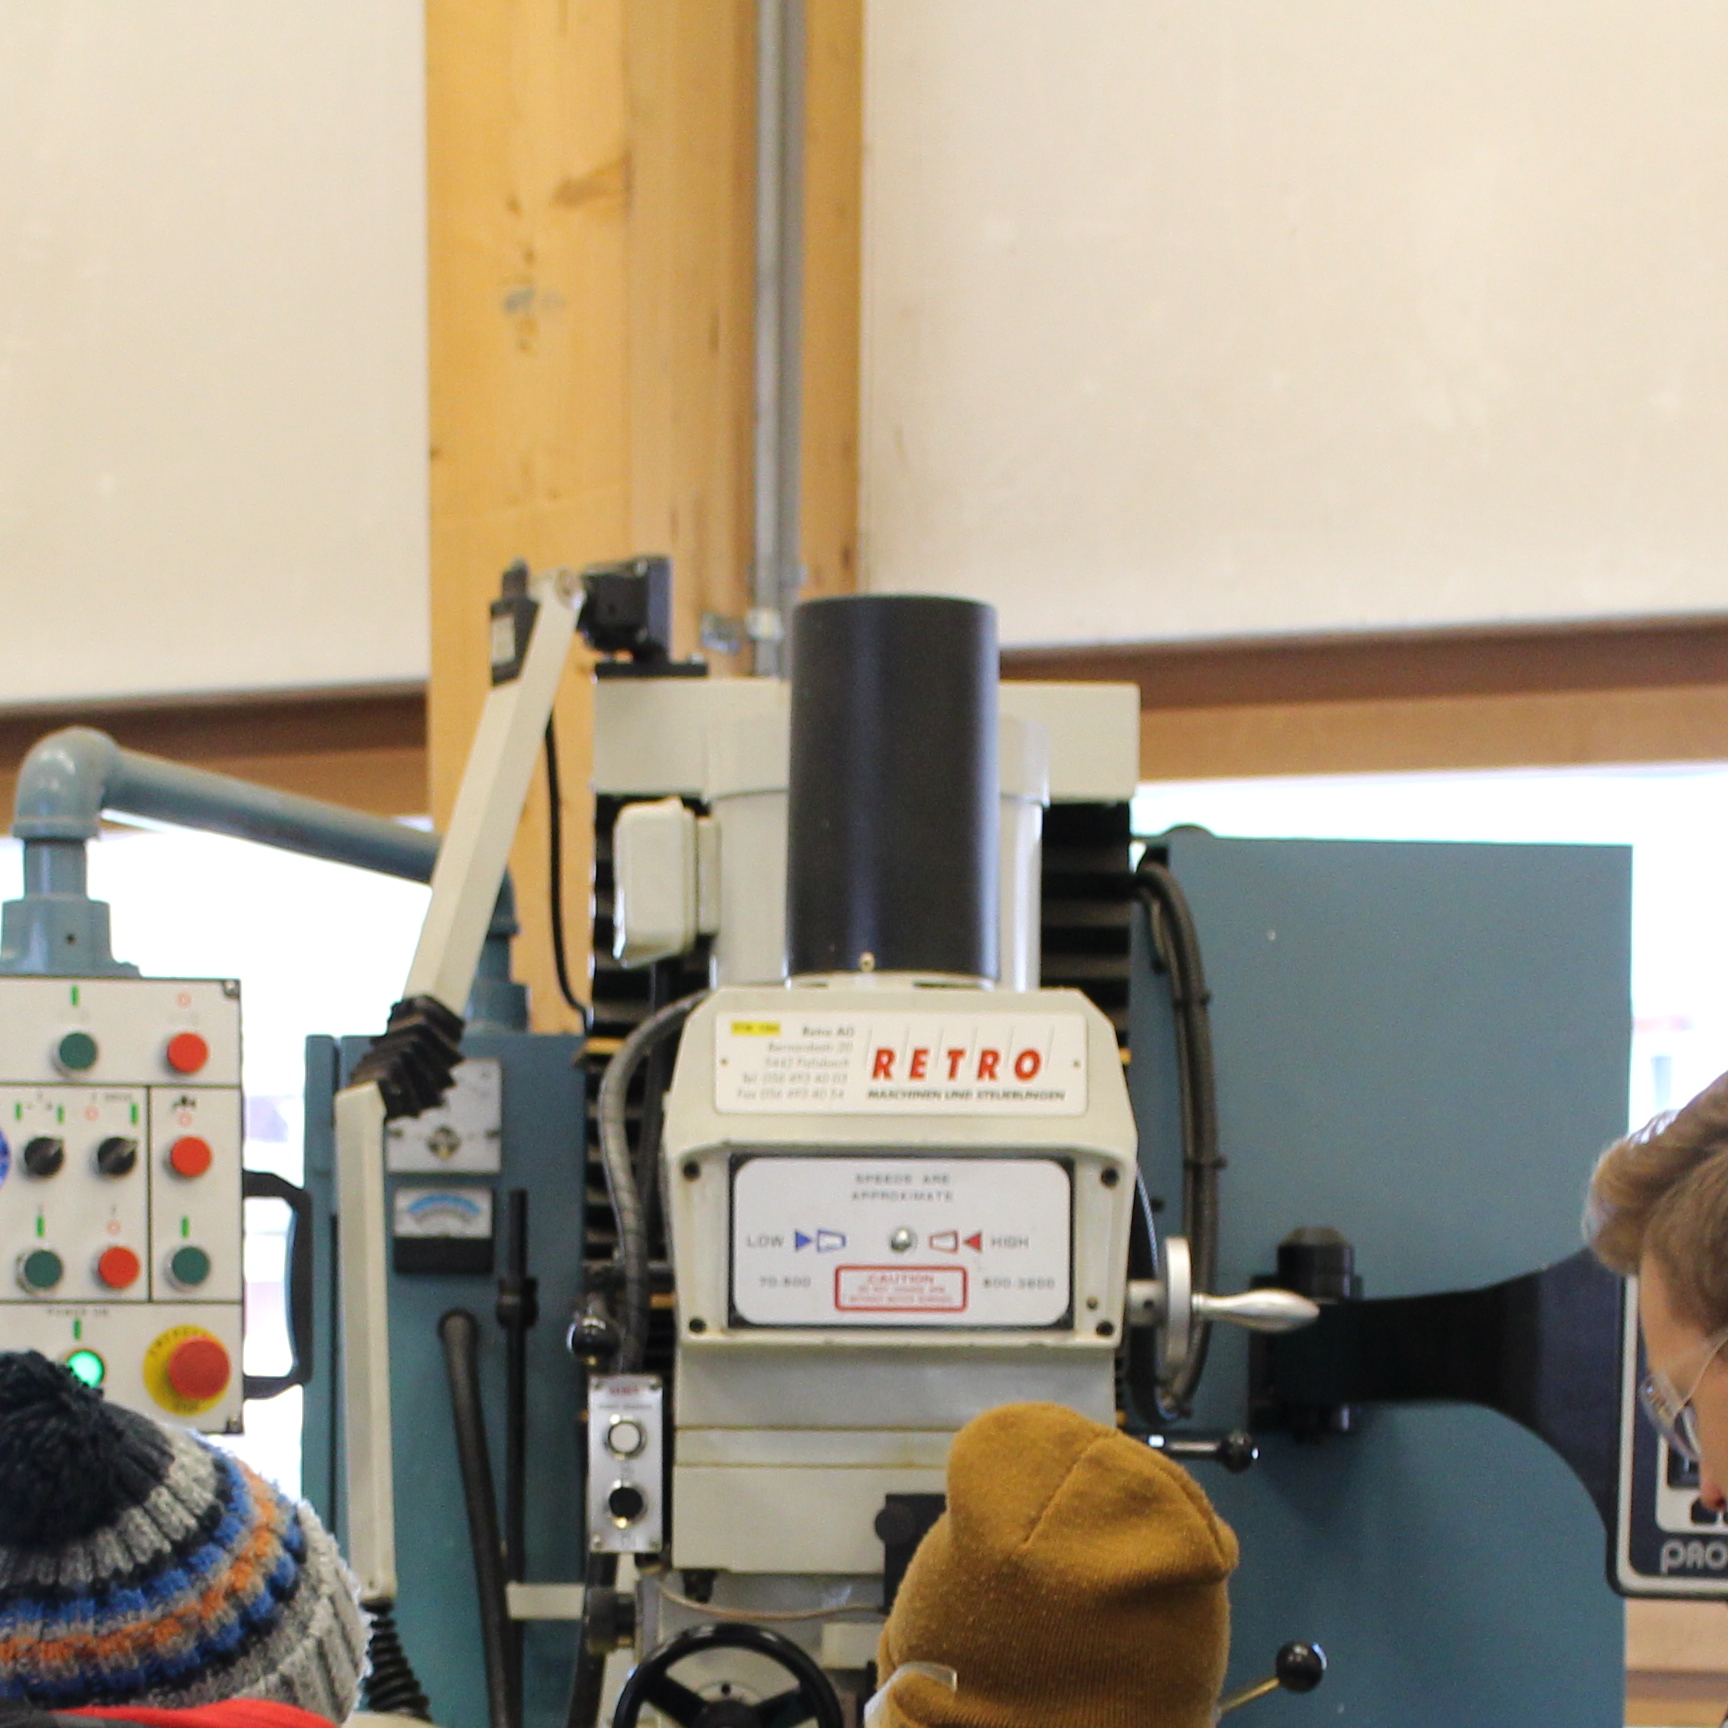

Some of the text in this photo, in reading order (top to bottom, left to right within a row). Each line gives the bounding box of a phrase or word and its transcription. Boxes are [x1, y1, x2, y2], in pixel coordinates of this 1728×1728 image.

[872, 1048, 1041, 1081] RETRO
[851, 1190, 954, 1201] APPROXIMATE
[747, 1235, 785, 1248] LOW
[990, 1236, 1030, 1247] HIGH
[867, 1274, 936, 1285] CAUTION
